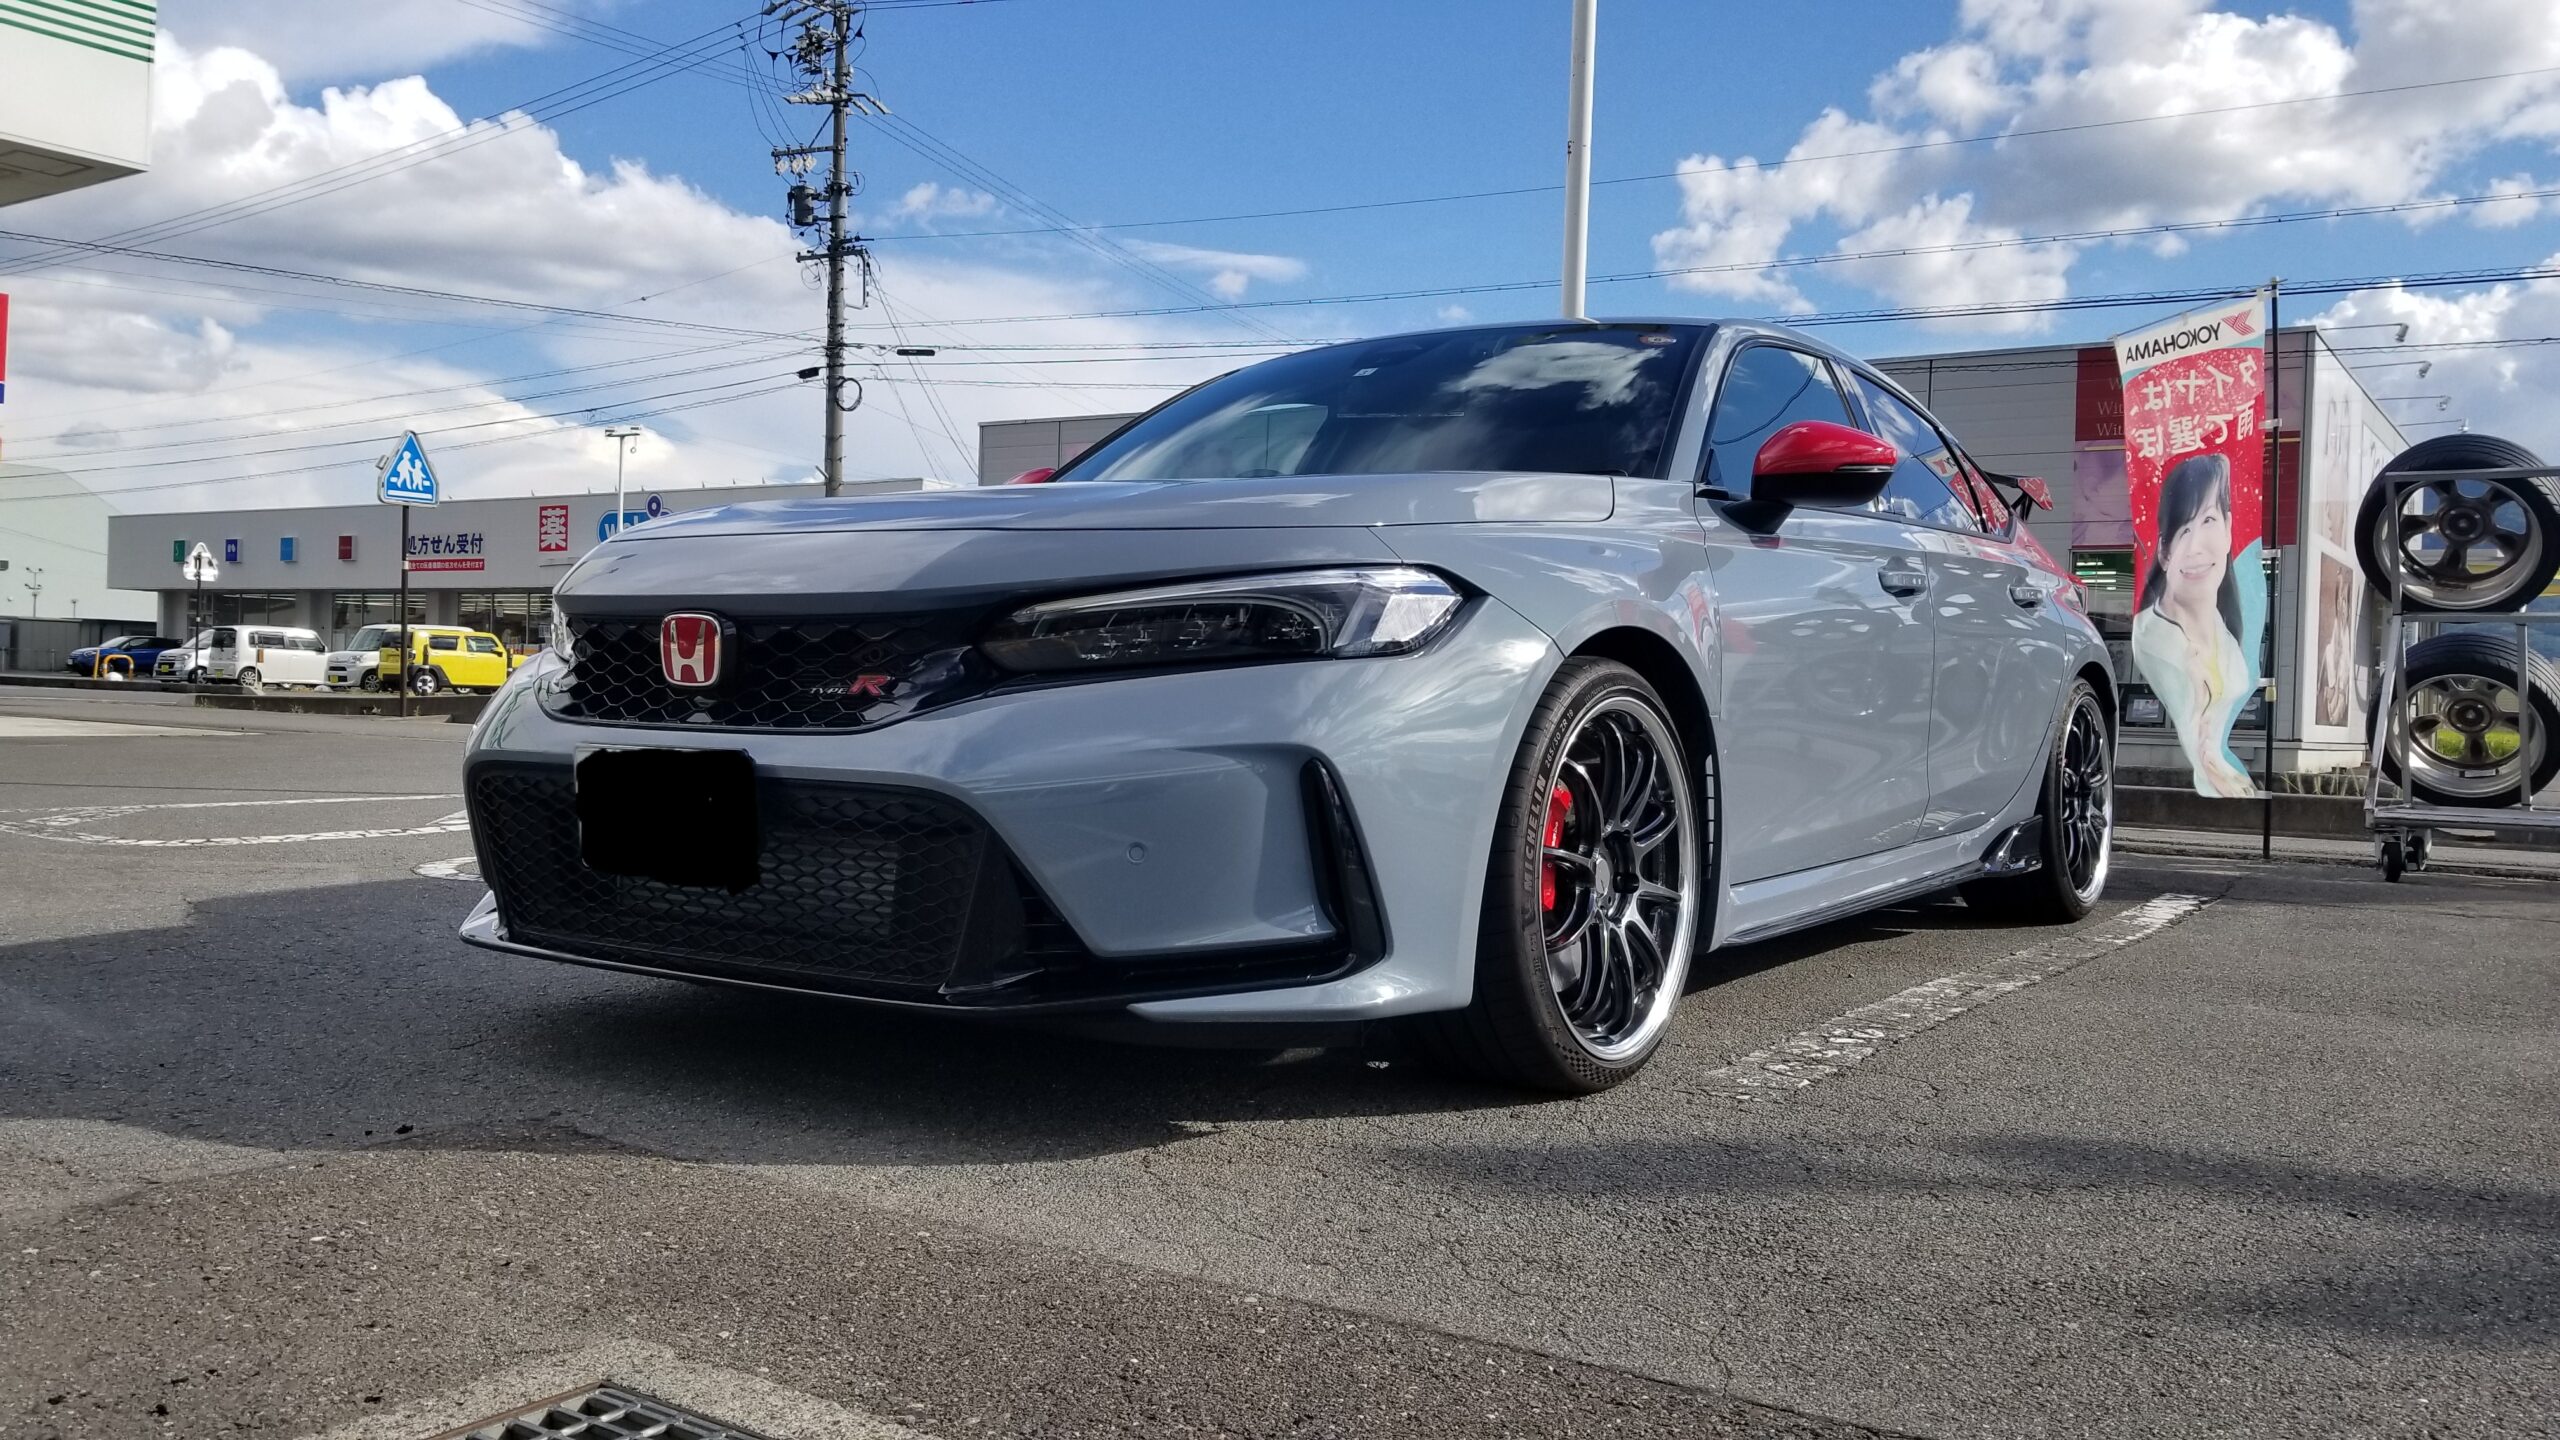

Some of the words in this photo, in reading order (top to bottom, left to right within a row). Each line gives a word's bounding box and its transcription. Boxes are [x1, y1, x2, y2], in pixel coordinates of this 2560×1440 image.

[408, 533, 484, 555] 処方せん受付
[541, 507, 567, 550] 薬
[847, 675, 888, 697] R
[1523, 773, 1547, 892] MICHELIN
